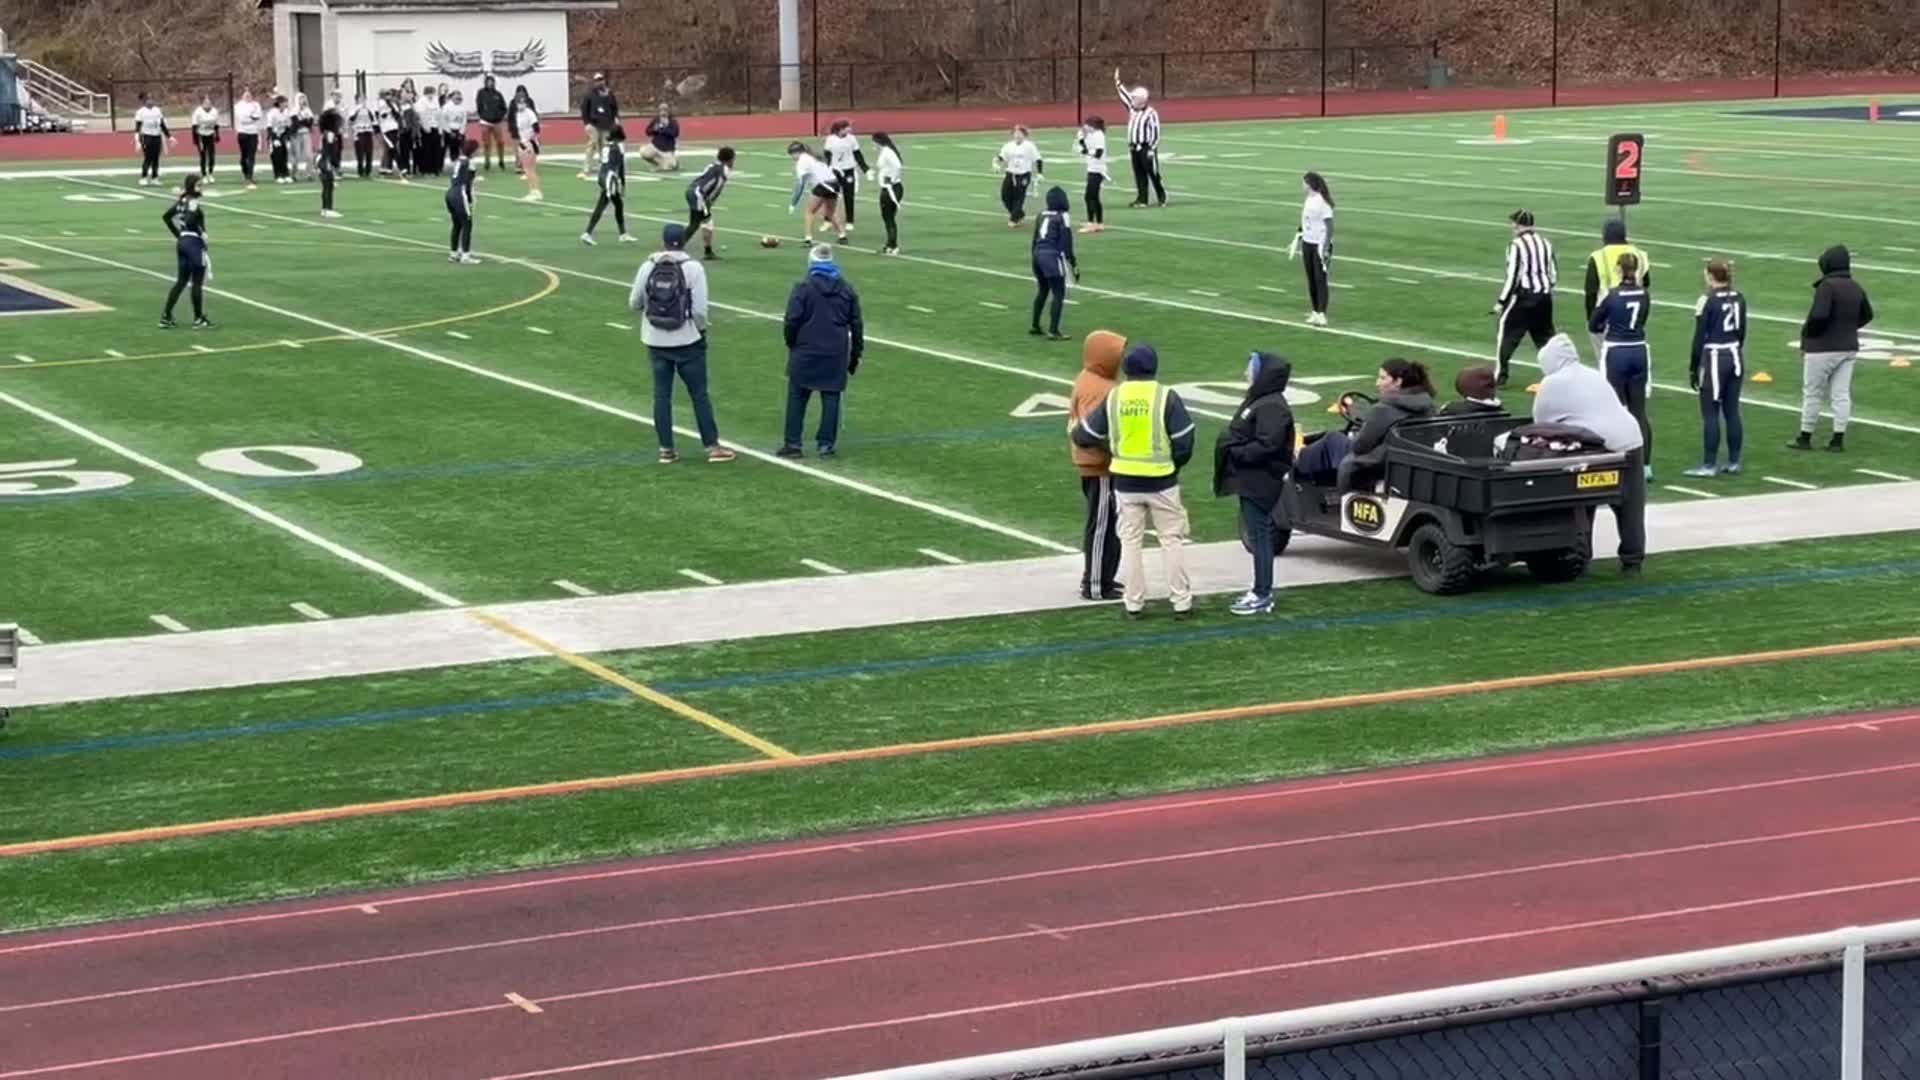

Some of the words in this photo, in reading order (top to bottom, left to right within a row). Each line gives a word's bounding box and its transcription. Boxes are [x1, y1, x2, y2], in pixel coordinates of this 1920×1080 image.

[1616, 141, 1639, 178] 2
[1626, 301, 1641, 330] 7
[1721, 301, 1741, 332] 21
[1119, 407, 1150, 417] SAFETY
[1353, 501, 1379, 523] NFA
